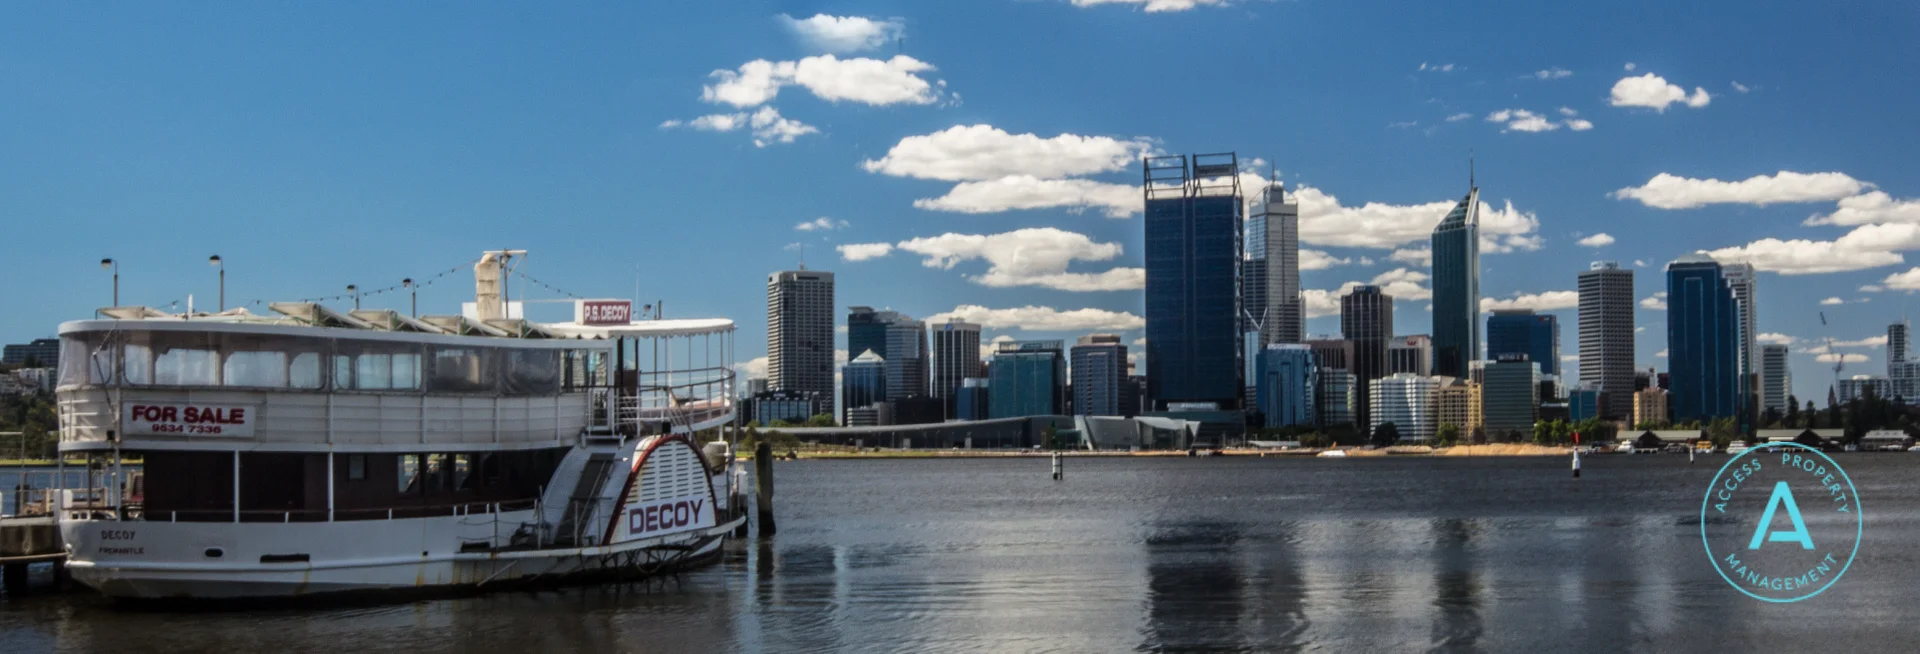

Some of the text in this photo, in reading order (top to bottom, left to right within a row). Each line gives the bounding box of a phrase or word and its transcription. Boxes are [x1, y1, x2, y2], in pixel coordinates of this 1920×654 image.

[601, 304, 630, 320] DECOY
[132, 405, 245, 424] FOR SALE
[629, 498, 704, 535] DECOY
[101, 530, 136, 540] DECOY
[98, 546, 145, 556] FREMANTLE
